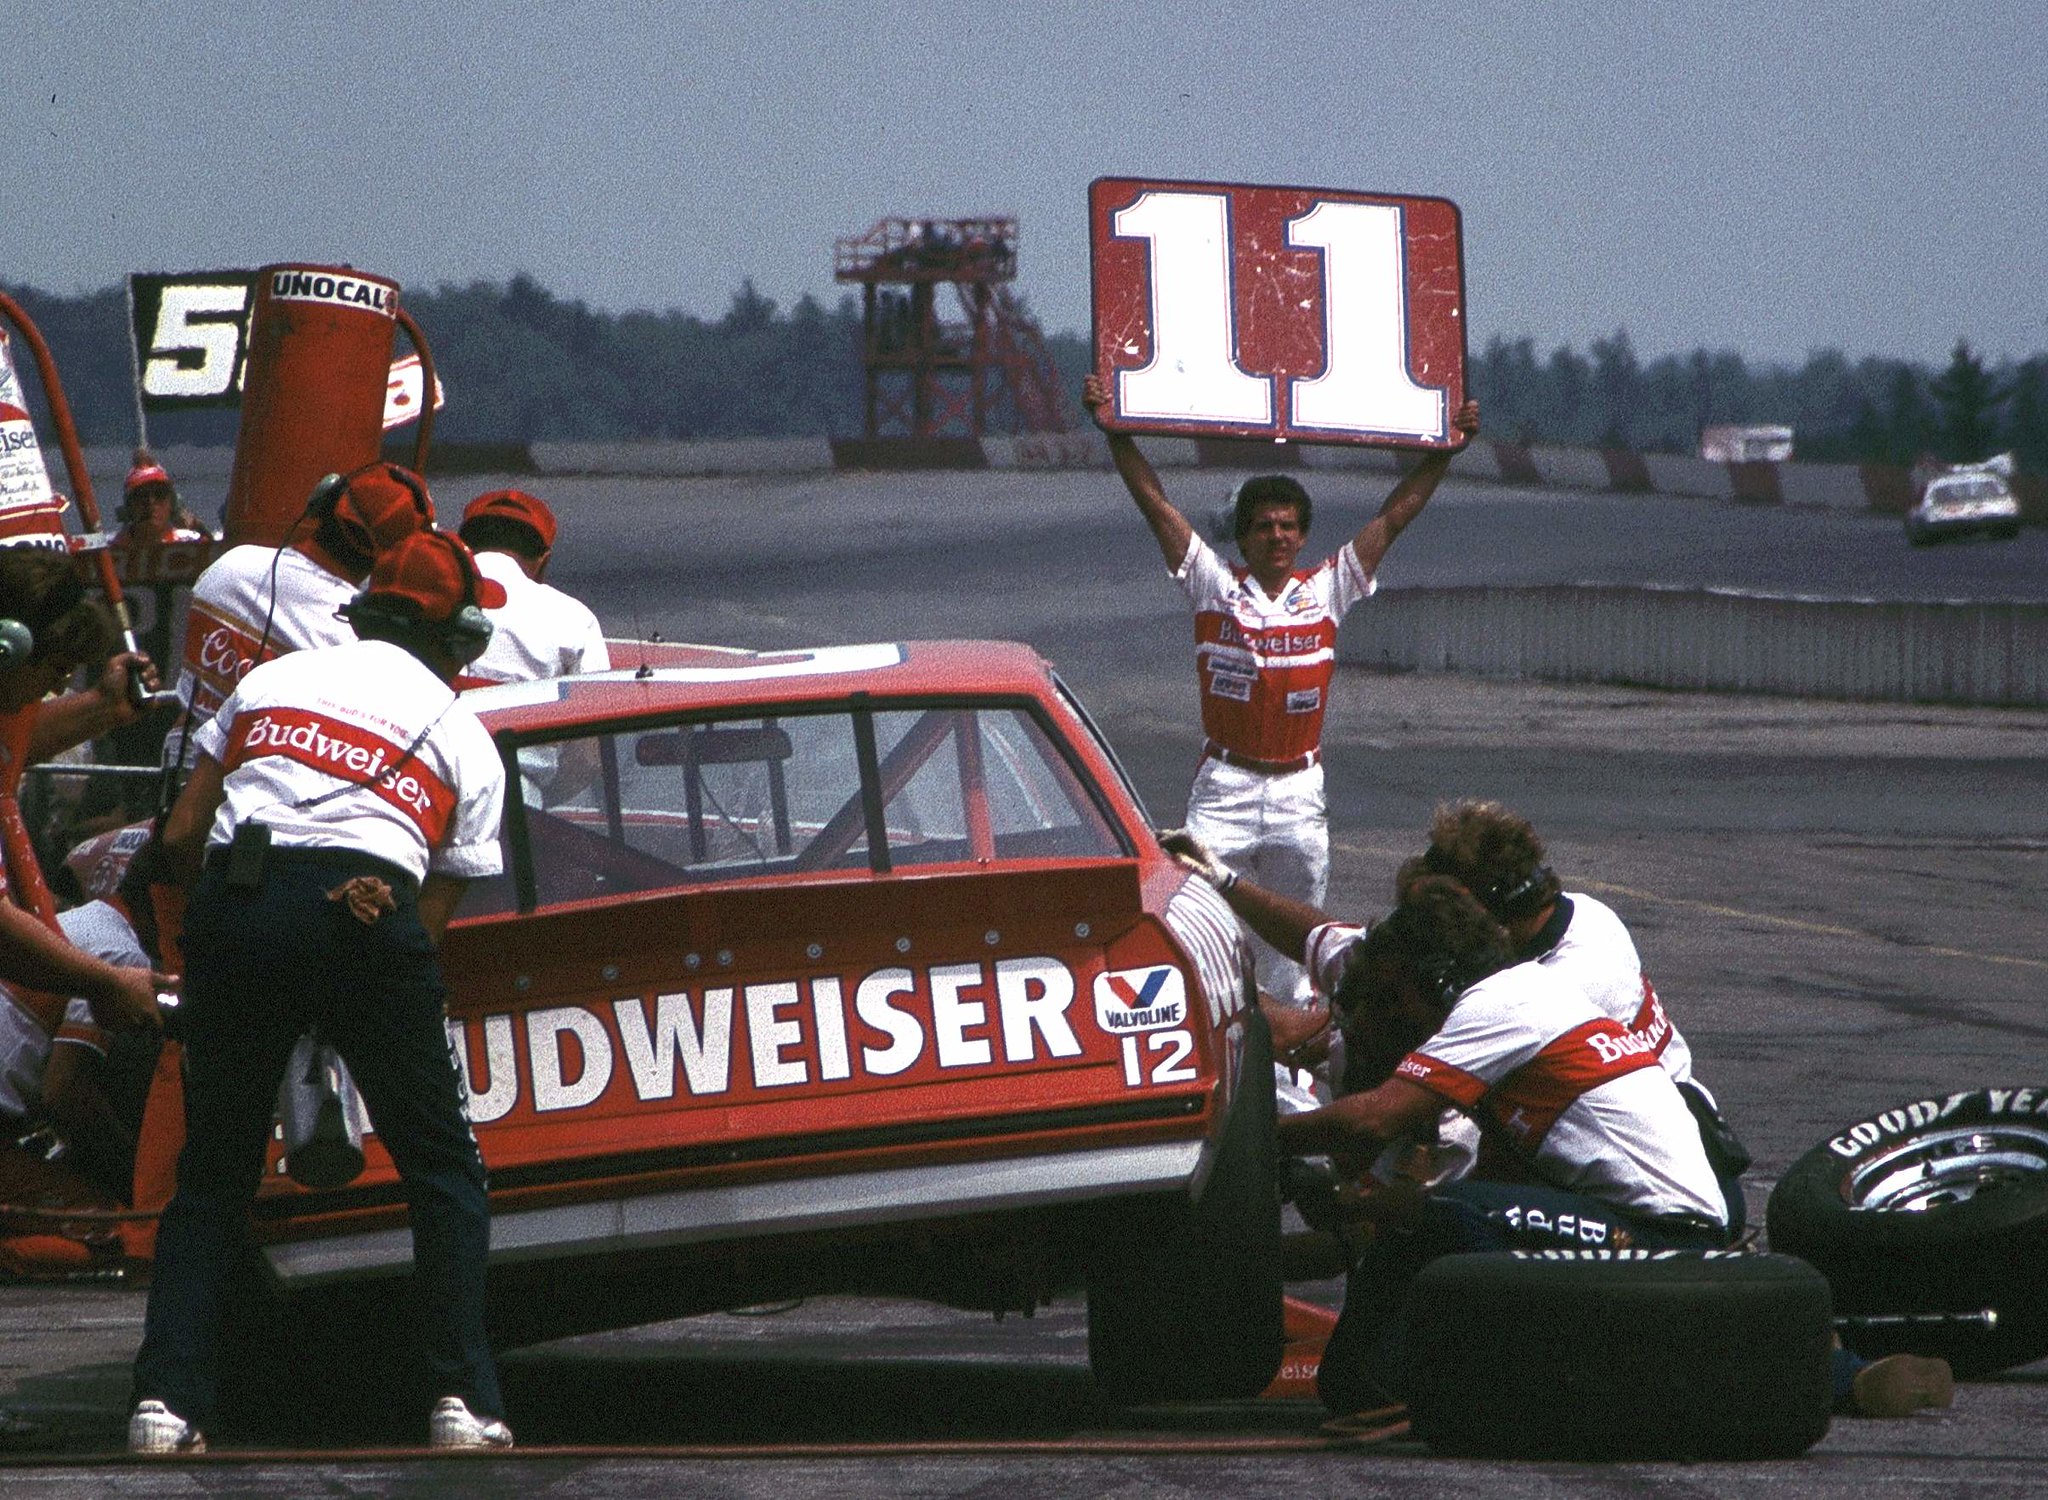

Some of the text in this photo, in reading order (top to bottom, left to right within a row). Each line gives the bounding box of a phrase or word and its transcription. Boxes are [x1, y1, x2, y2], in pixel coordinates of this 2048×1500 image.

[144, 284, 254, 396] 5
[273, 273, 384, 310] UNOCAL
[1112, 192, 1446, 439] 11
[245, 716, 431, 814] Budweiser
[447, 956, 1082, 1123] UDWEISER
[1105, 1002, 1181, 1028] VALVOLINE
[1121, 1029, 1197, 1086] 12
